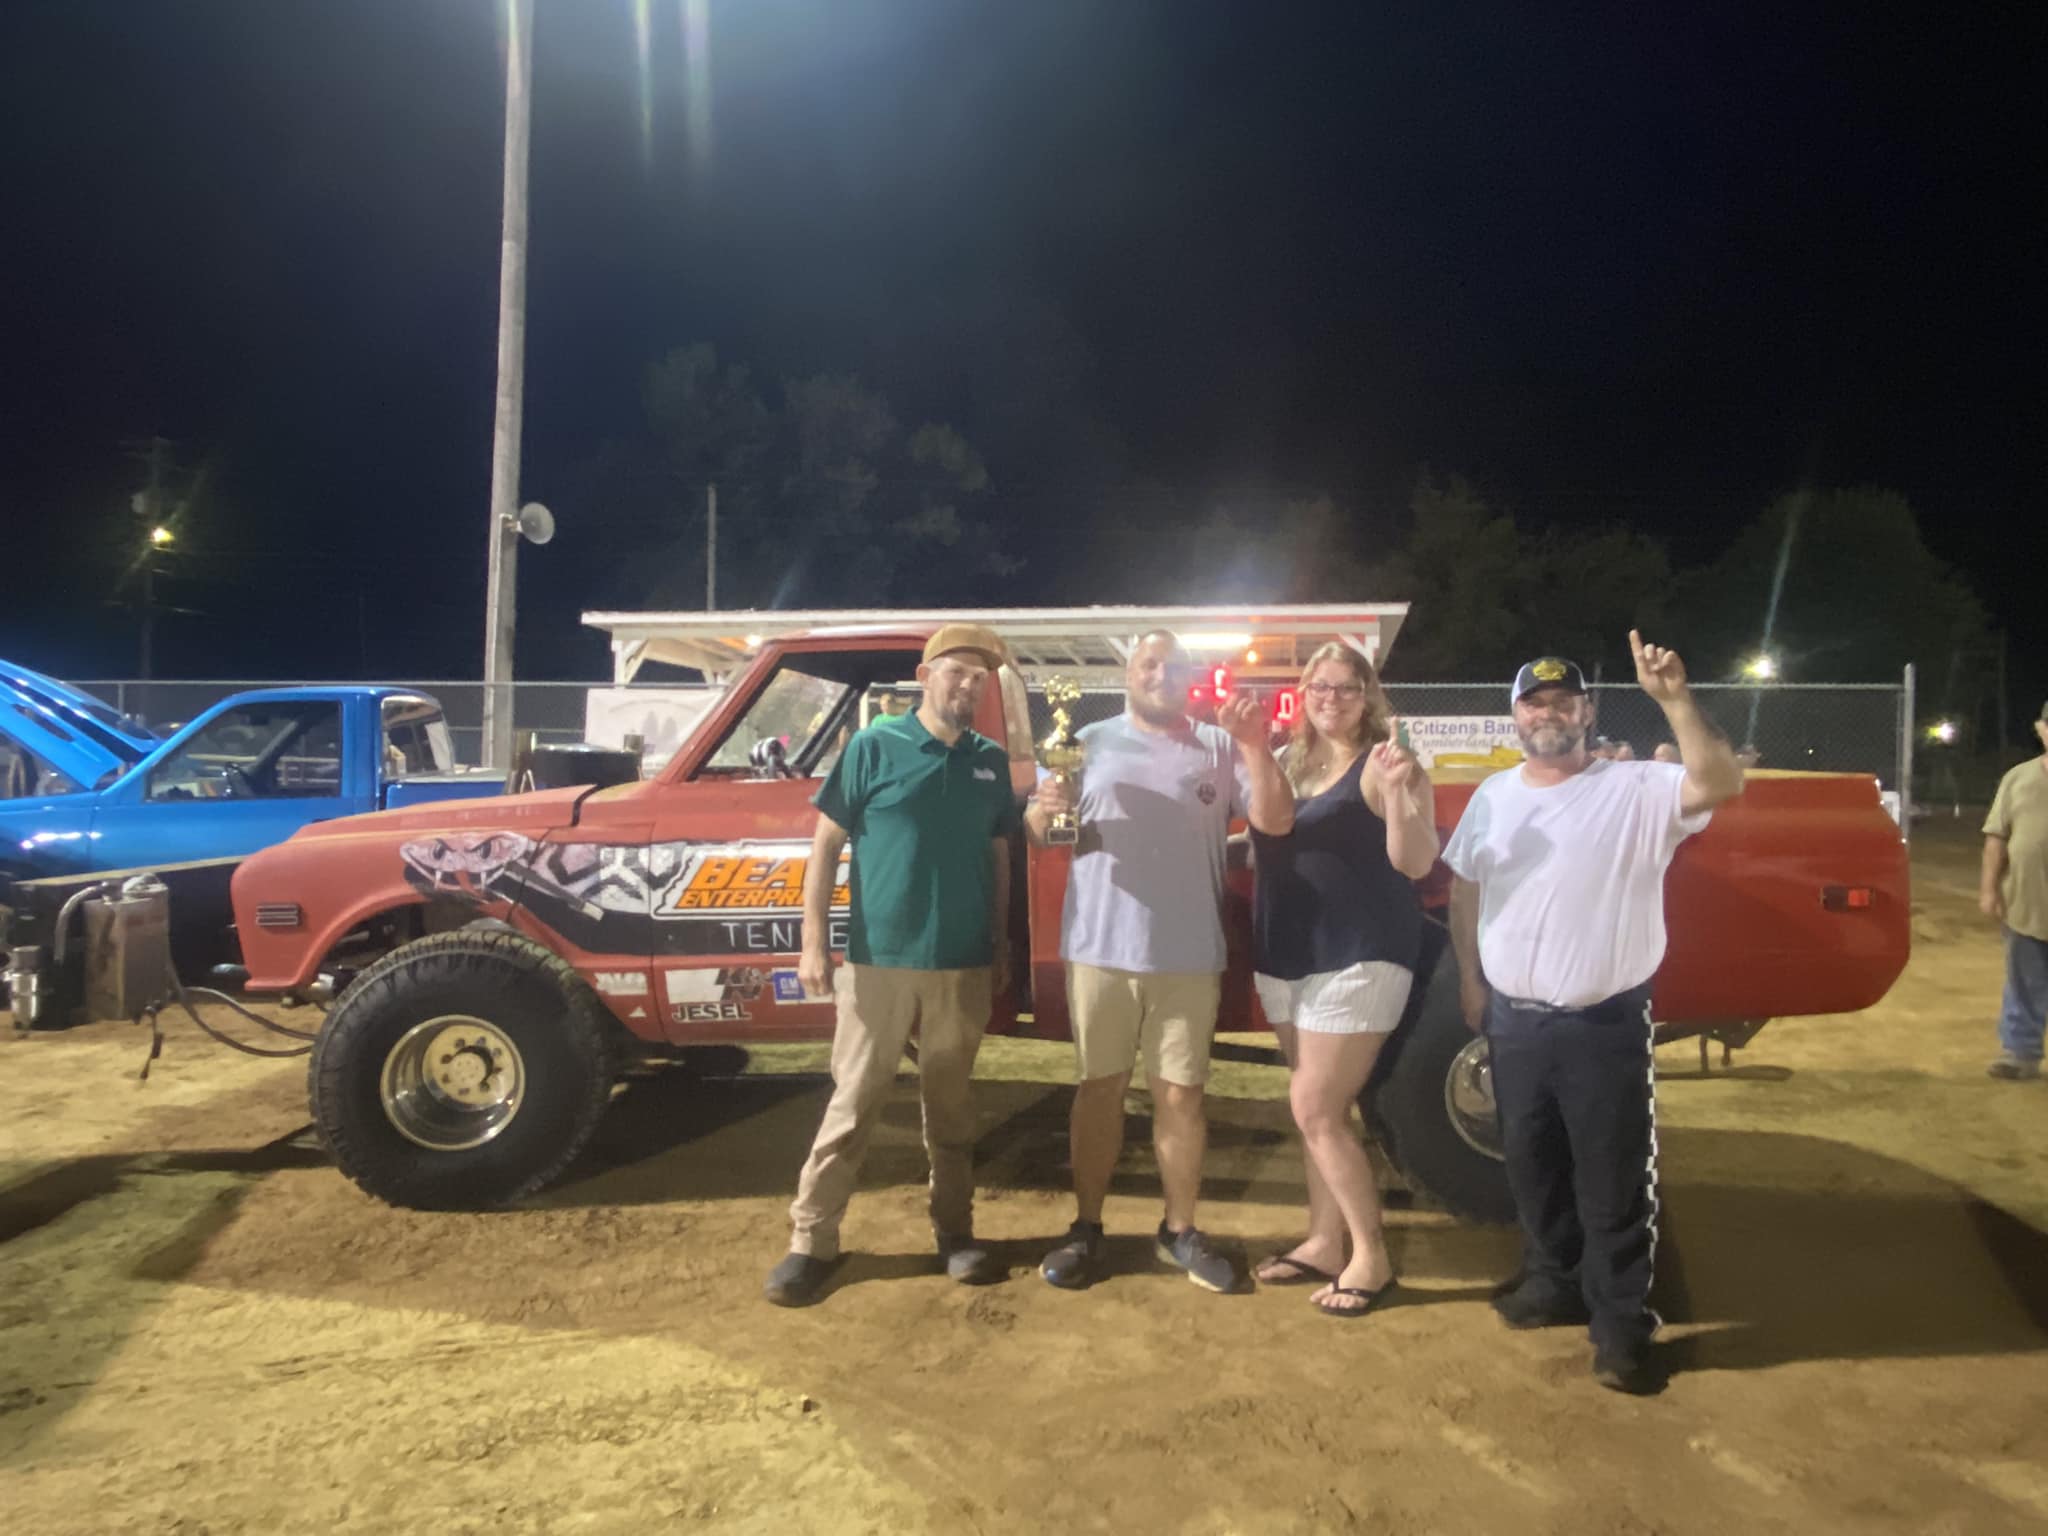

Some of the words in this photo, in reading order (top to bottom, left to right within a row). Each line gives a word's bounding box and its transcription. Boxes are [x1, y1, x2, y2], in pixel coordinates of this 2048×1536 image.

[1412, 720, 1478, 735] Citizens
[1484, 719, 1519, 735] Ban
[720, 921, 849, 949] TENE
[673, 1003, 751, 1022] JESEL
